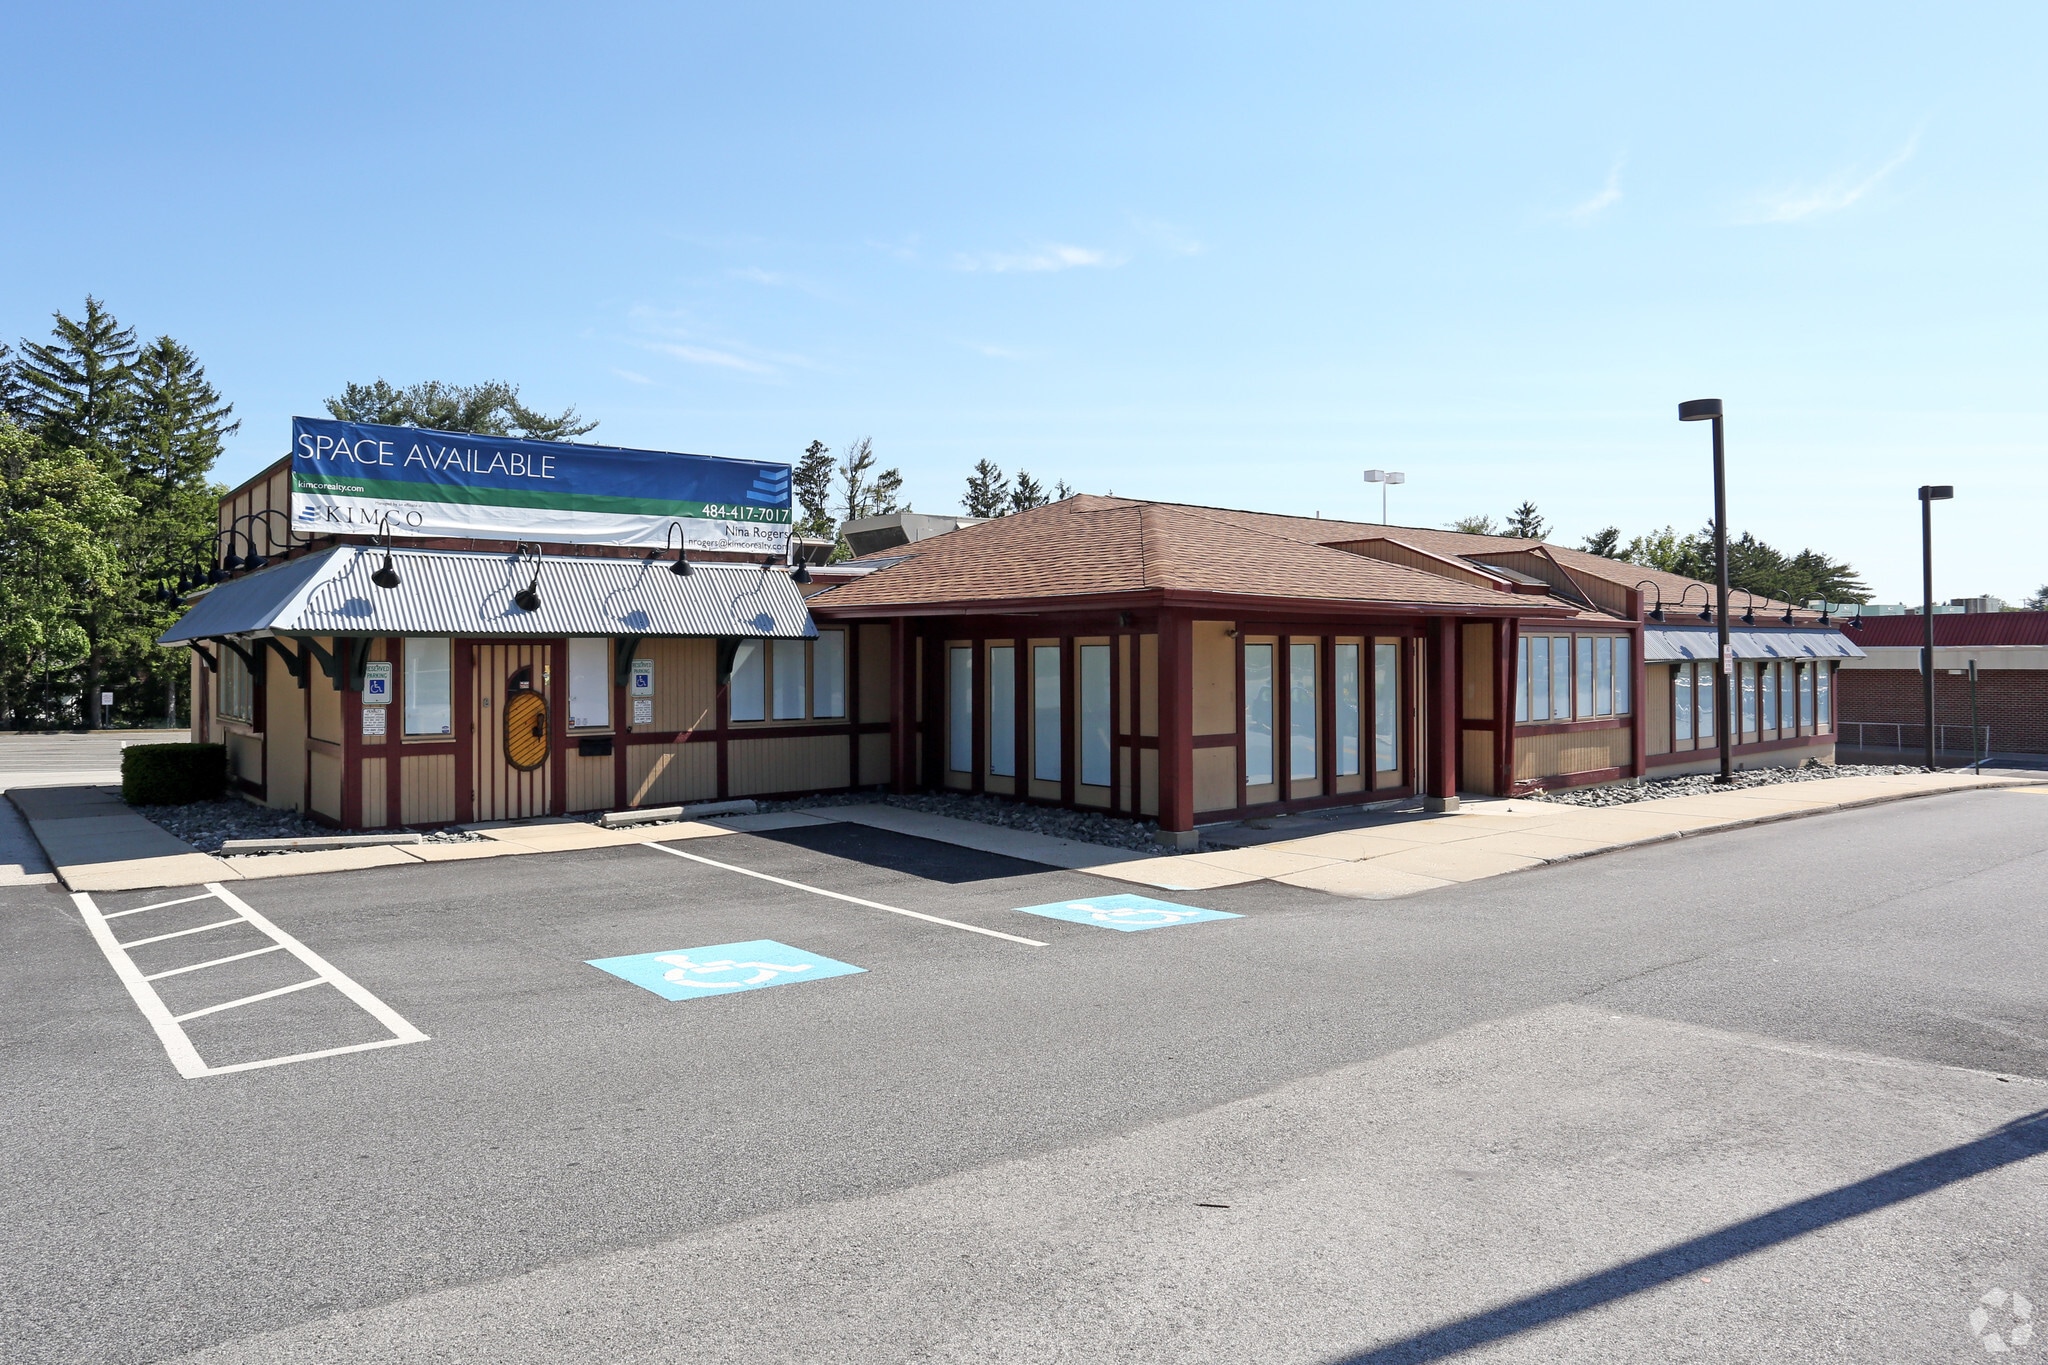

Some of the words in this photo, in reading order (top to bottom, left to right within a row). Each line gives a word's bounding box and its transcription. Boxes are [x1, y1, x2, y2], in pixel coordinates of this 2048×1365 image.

[298, 433, 394, 466] SPACE
[403, 443, 556, 479] AVAILABLE
[298, 480, 364, 492] kimcorealty.com
[325, 505, 423, 527] KIMCO
[702, 504, 789, 522] 484-417-7017
[725, 525, 750, 537] Nina
[753, 526, 789, 541] Rogers
